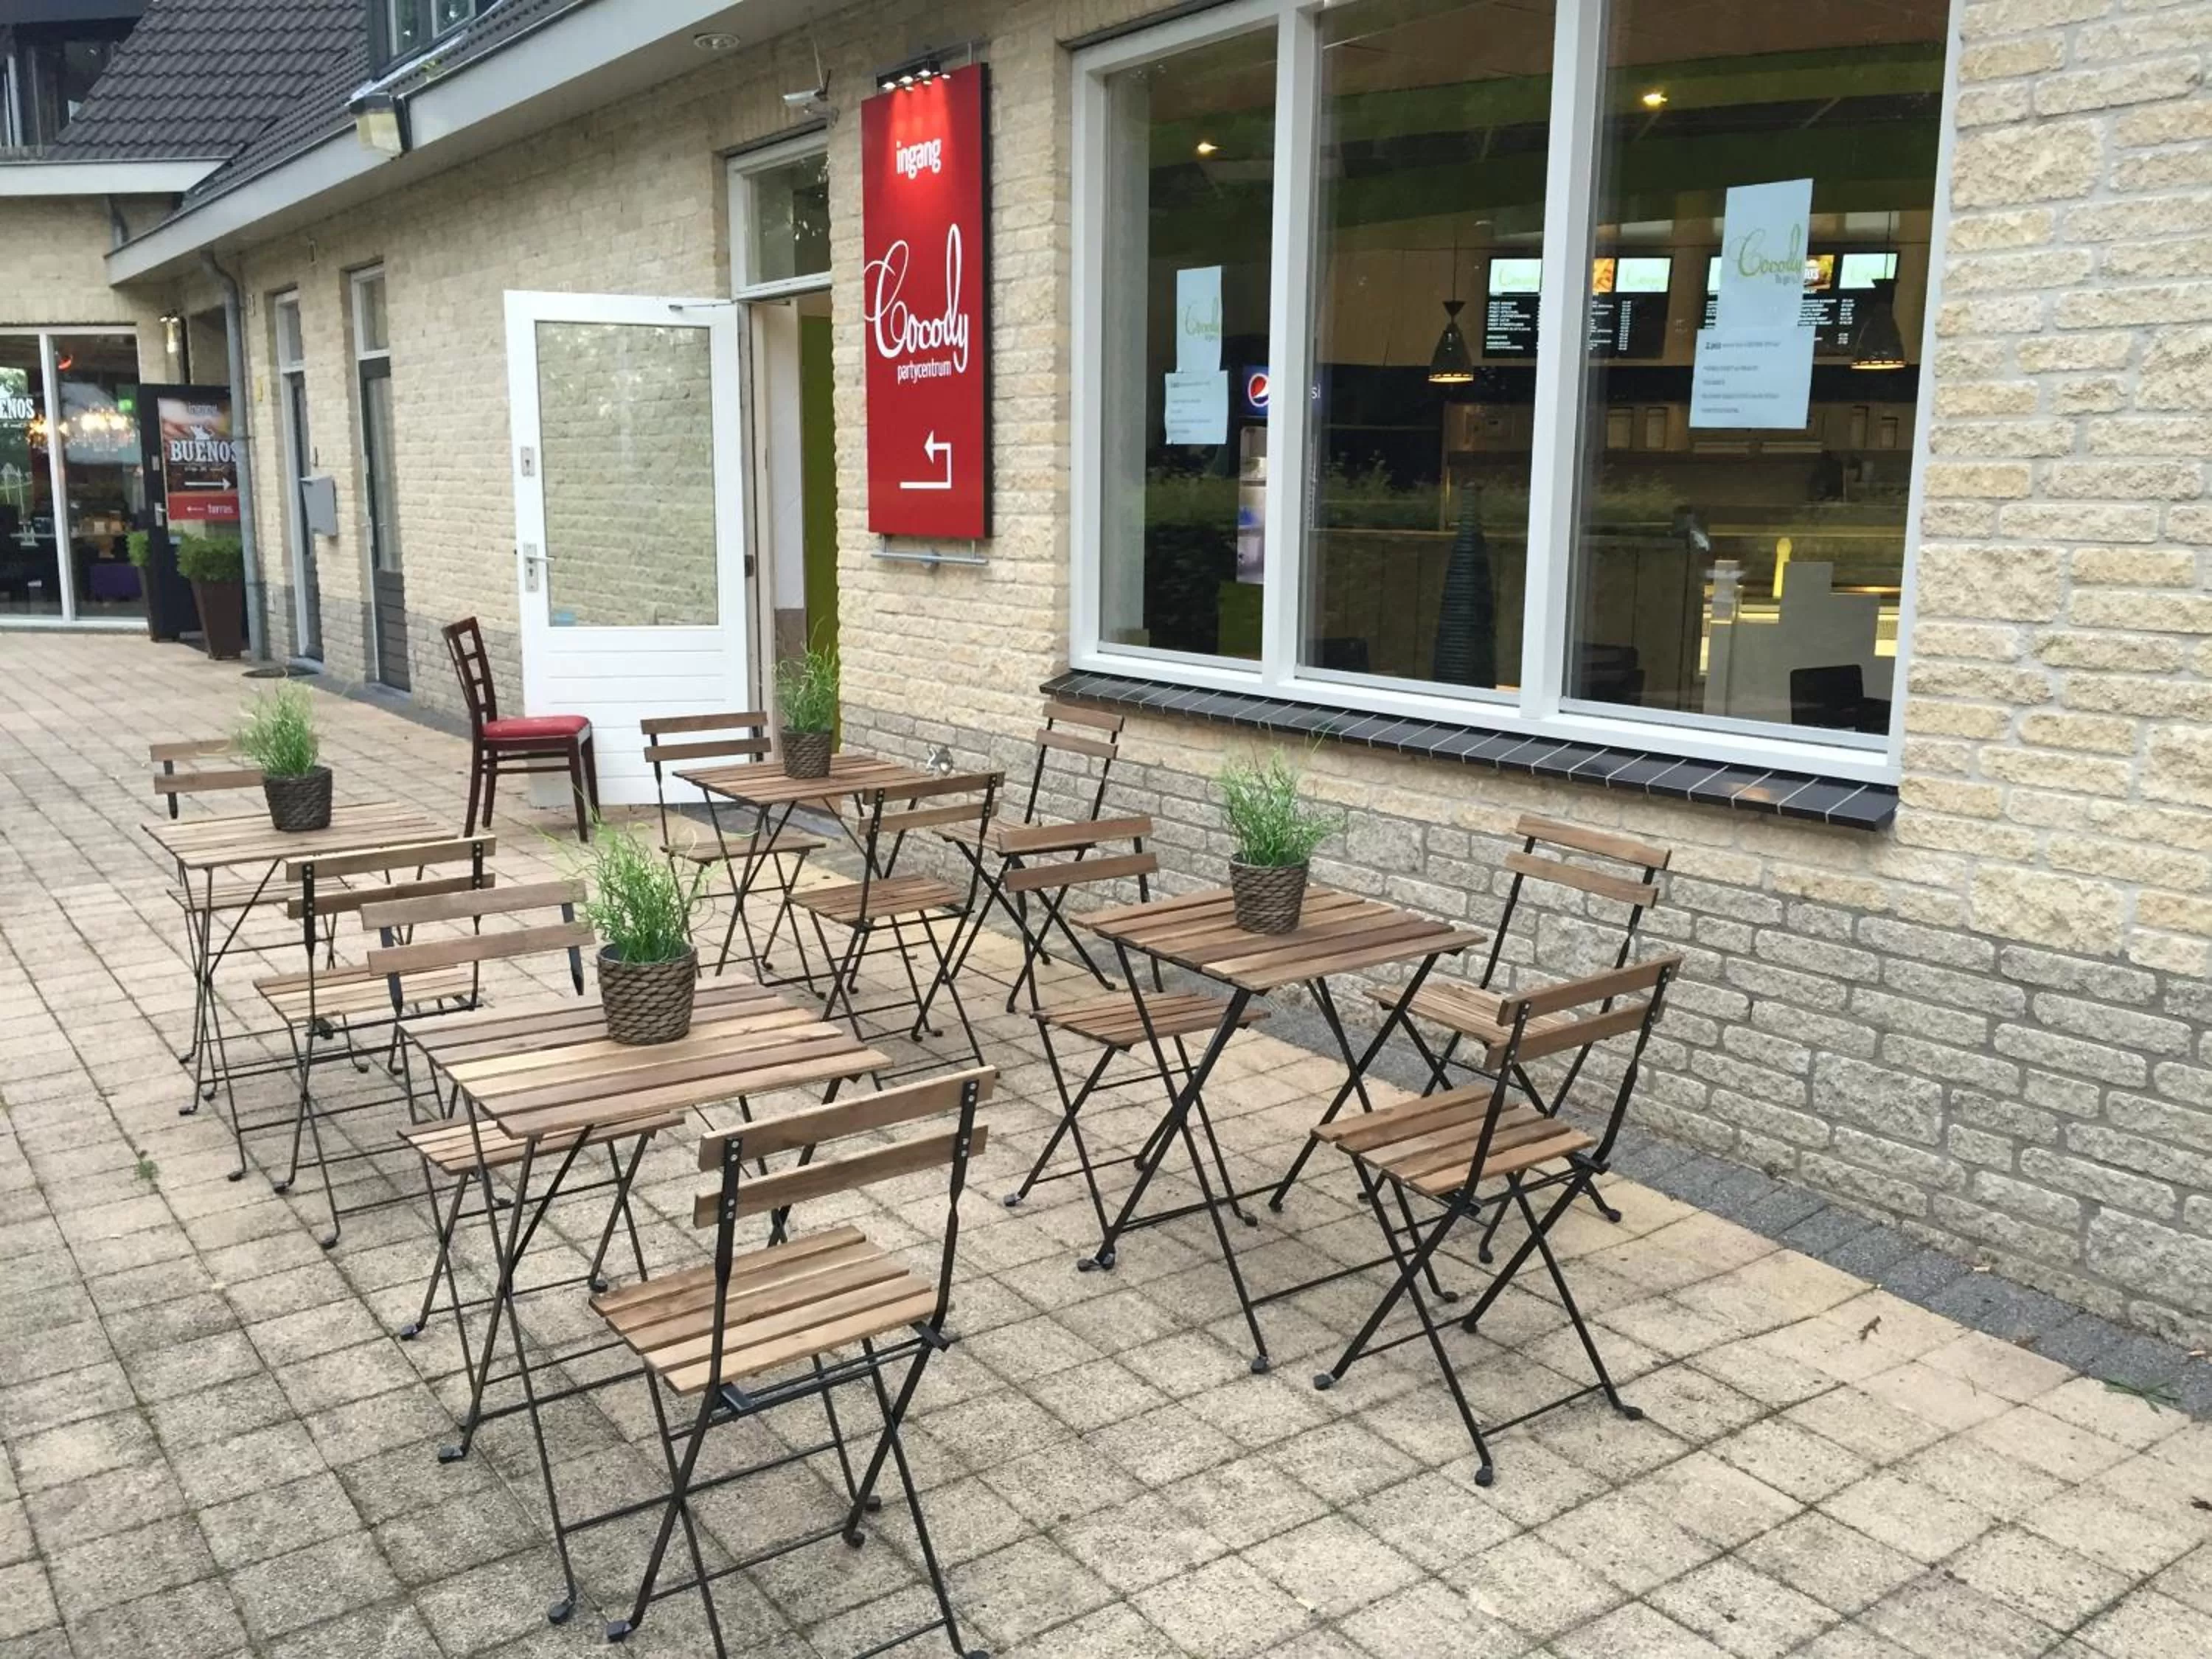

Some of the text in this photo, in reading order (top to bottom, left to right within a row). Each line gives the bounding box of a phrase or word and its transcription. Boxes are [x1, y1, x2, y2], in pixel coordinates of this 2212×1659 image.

[896, 139, 942, 179] ingang
[863, 223, 969, 374] Cocody
[897, 358, 952, 385] partycentrum
